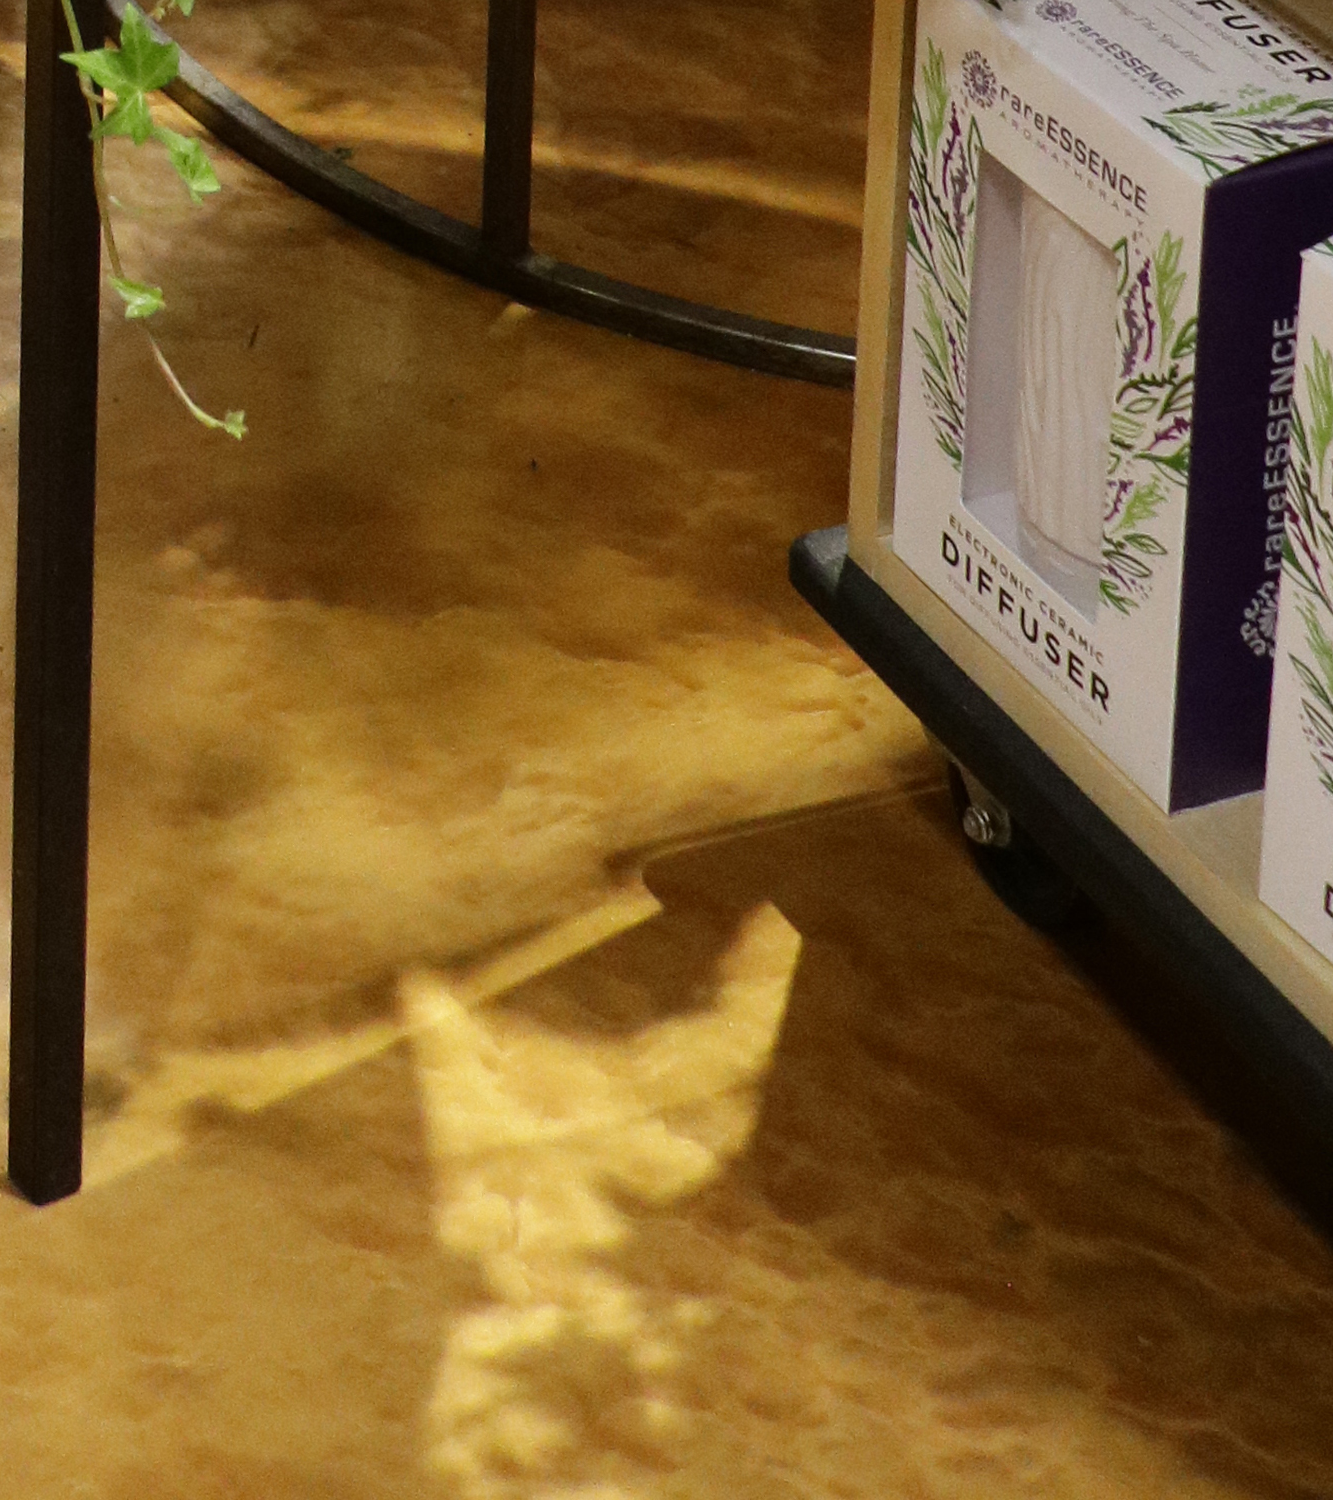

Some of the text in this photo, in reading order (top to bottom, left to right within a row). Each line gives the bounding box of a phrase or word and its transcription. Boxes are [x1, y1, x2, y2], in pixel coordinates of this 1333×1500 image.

[1071, 16, 1185, 100] rareESSENCE
[999, 109, 1145, 227] AROMATHERAPY
[1000, 83, 1148, 214] rareESSENCE
[1262, 316, 1297, 573] rareESSENCE
[941, 530, 1110, 714] DIFFUSER
[949, 513, 1105, 666] ELECTRONIC CERAMIC
